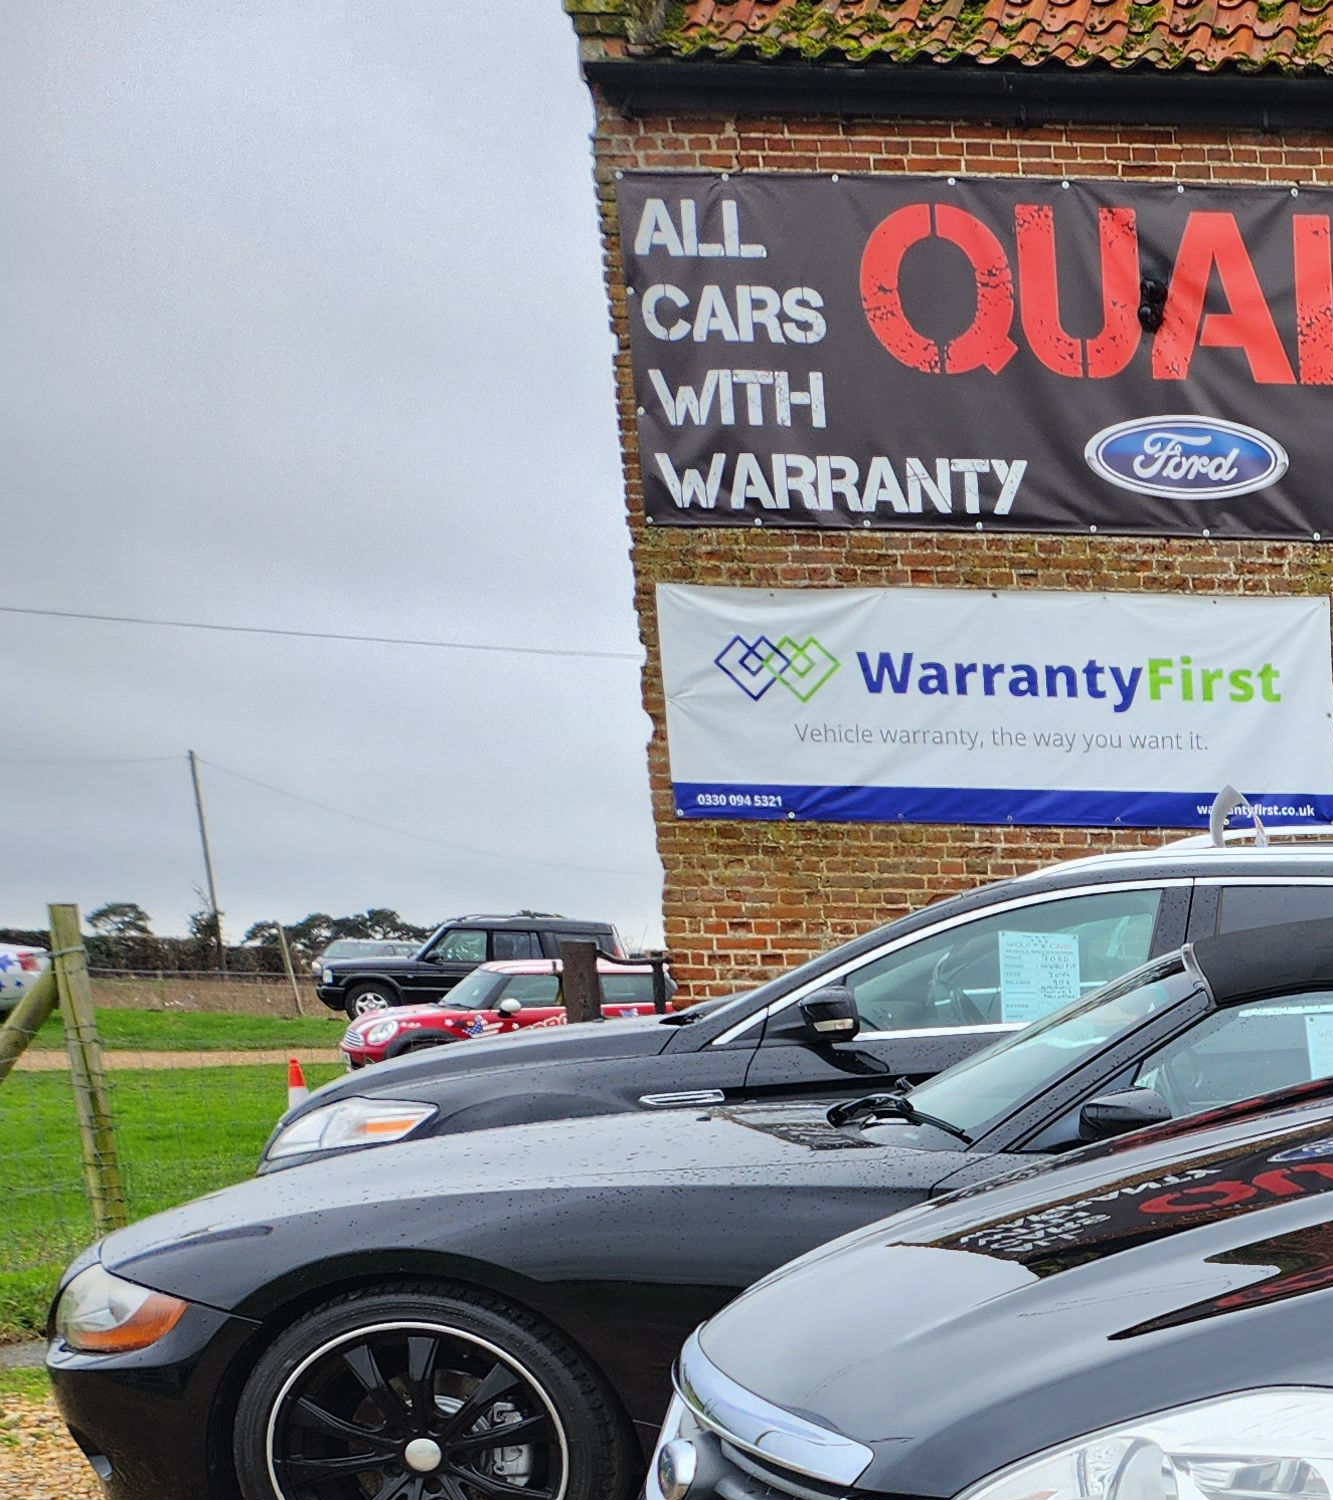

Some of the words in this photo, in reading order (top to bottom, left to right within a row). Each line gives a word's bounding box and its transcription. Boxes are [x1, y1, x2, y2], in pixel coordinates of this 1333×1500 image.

[634, 199, 766, 259] ALL
[641, 285, 826, 344] CARS
[648, 369, 826, 429] WITH
[656, 452, 1028, 515] WARRANTY
[1132, 432, 1239, 482] Ford
[856, 649, 1282, 713] WarrantyFirst
[795, 723, 873, 745] Vehicle
[881, 727, 984, 750] warranty,
[992, 727, 1027, 748] the
[1033, 732, 1077, 754] way
[1082, 732, 1123, 755] you
[1130, 730, 1180, 751] want
[1186, 730, 1209, 751] it.
[697, 793, 727, 808] 0330
[730, 794, 753, 808] 094
[756, 794, 783, 809] 5321
